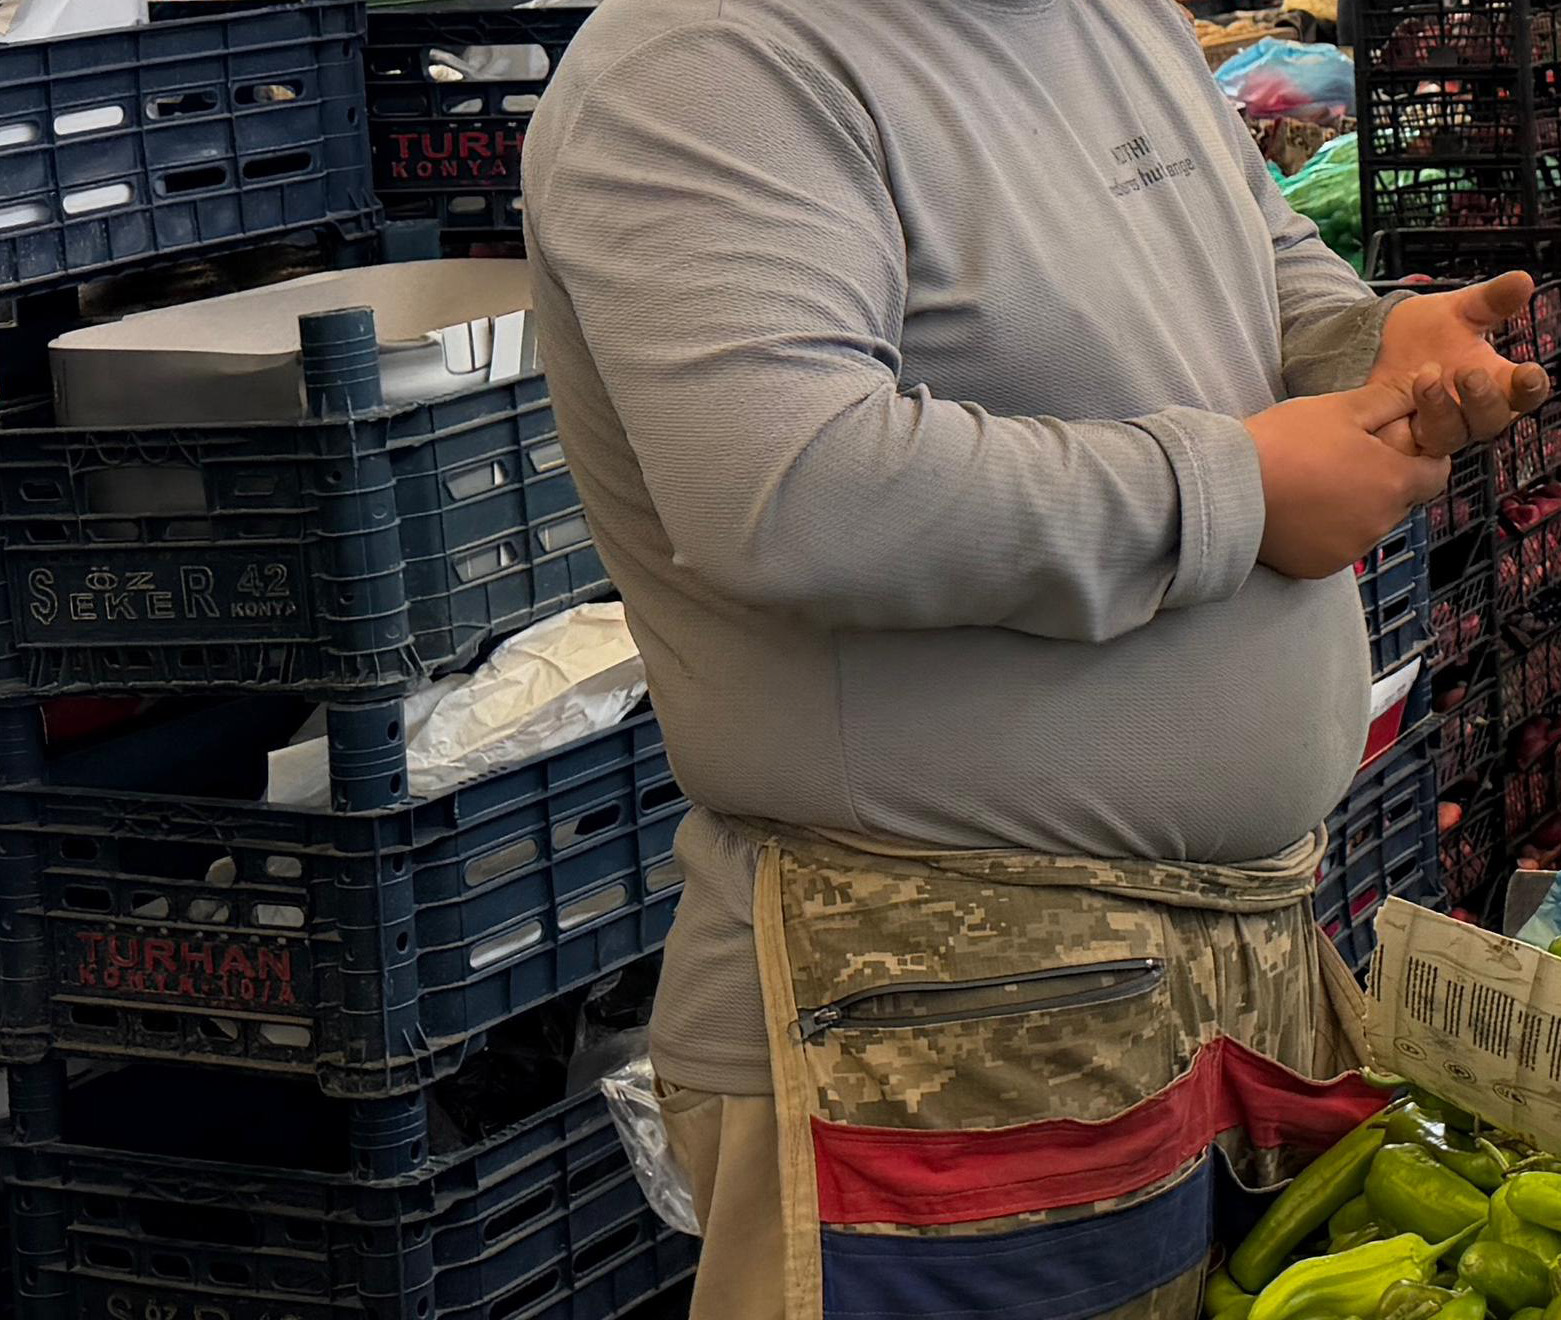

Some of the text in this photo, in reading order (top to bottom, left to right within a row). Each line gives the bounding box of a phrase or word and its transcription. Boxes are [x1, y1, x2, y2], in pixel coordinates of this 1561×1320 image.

[391, 159, 507, 179] KONYA
[84, 563, 290, 597] ÖZ 42
[230, 601, 297, 618] KONYA
[76, 931, 293, 981] TURHAN
